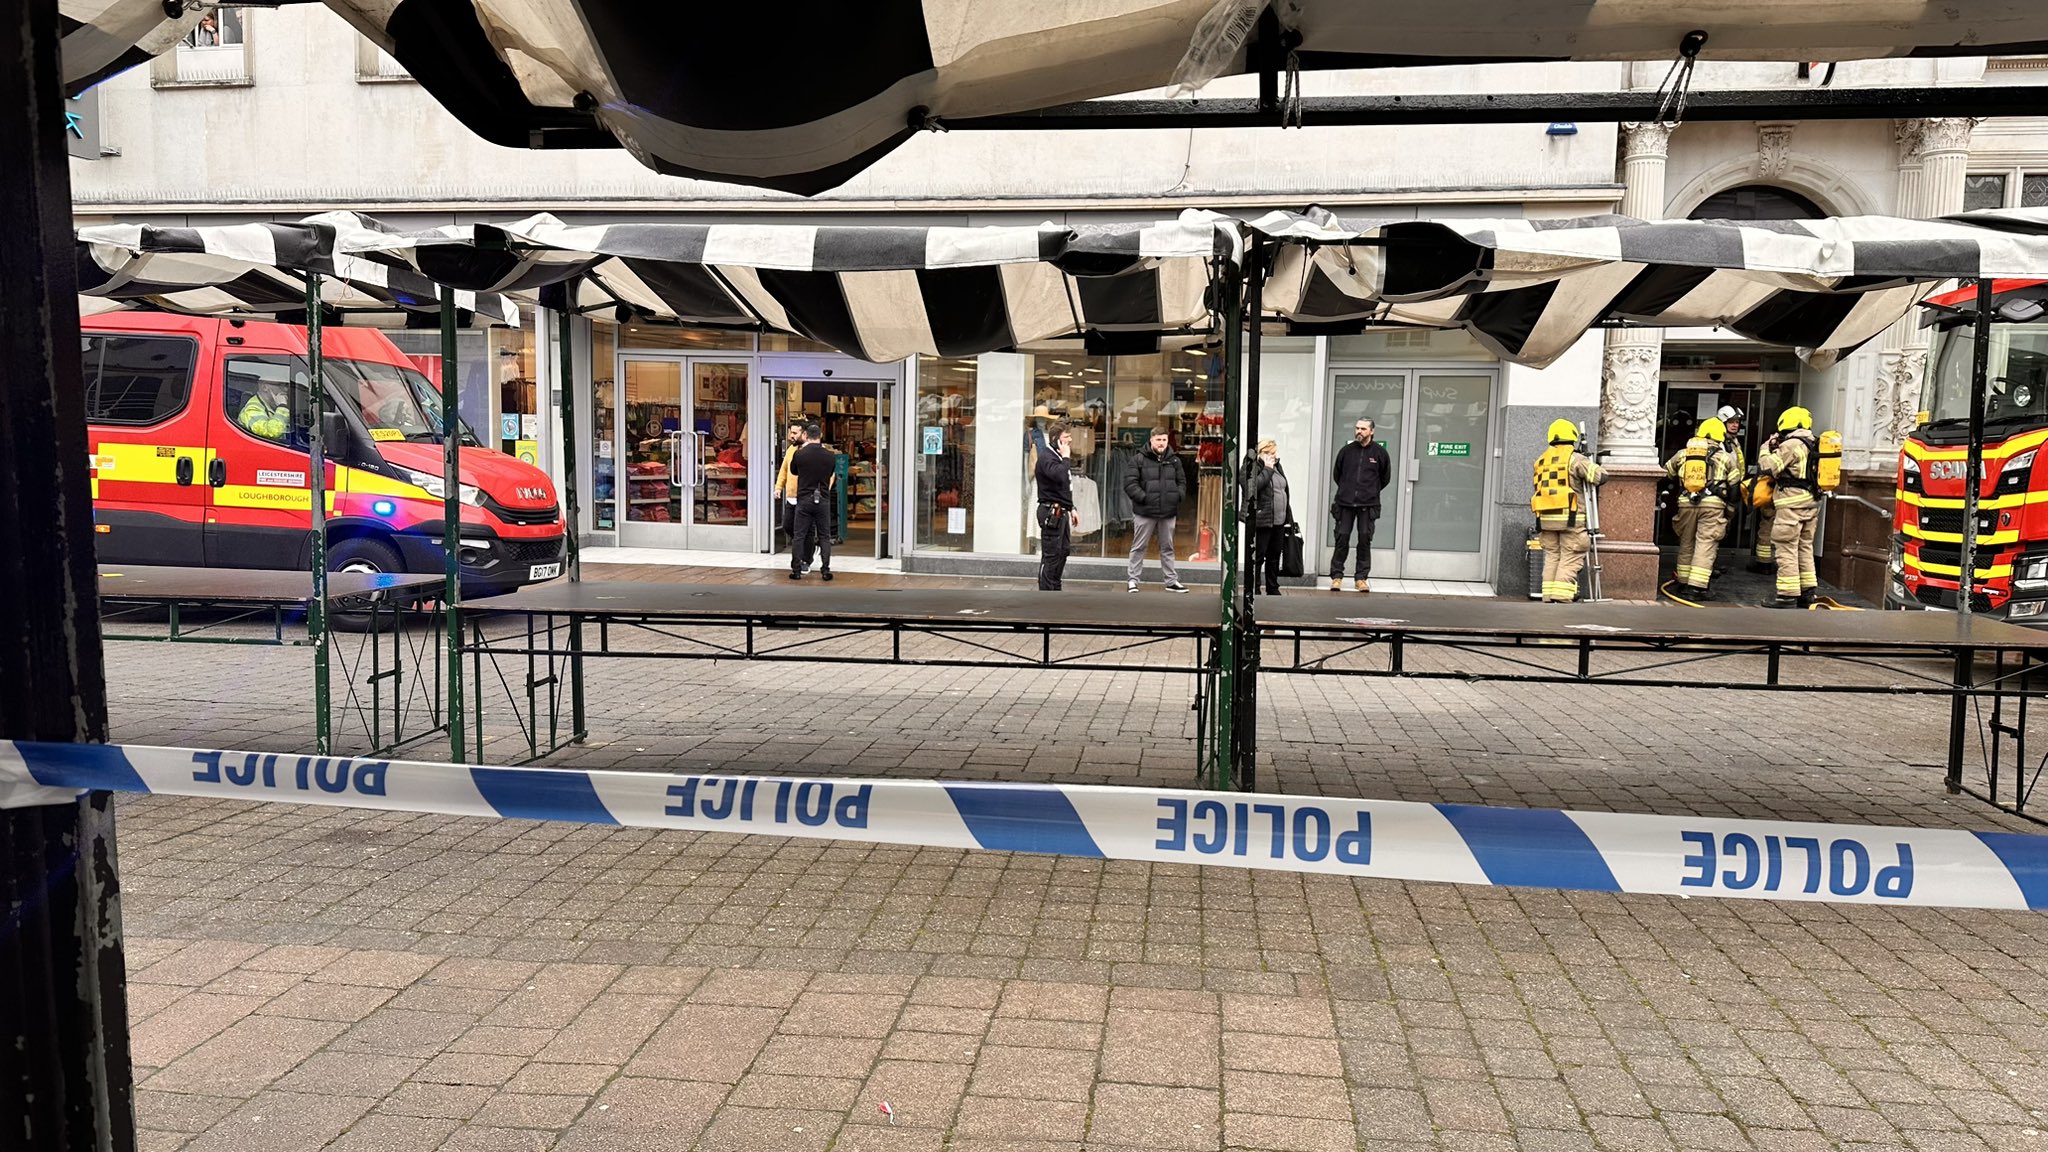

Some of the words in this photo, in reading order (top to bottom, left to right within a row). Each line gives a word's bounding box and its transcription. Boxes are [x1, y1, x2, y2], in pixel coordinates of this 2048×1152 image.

[258, 471, 304, 479] LEICESTERSHIRE
[1930, 461, 1987, 480] SCANA
[238, 491, 310, 503] LOUGHBOROUGH
[664, 776, 874, 829] POLICE
[1155, 798, 1372, 865] POLICE
[1680, 830, 1915, 899] POLICE
